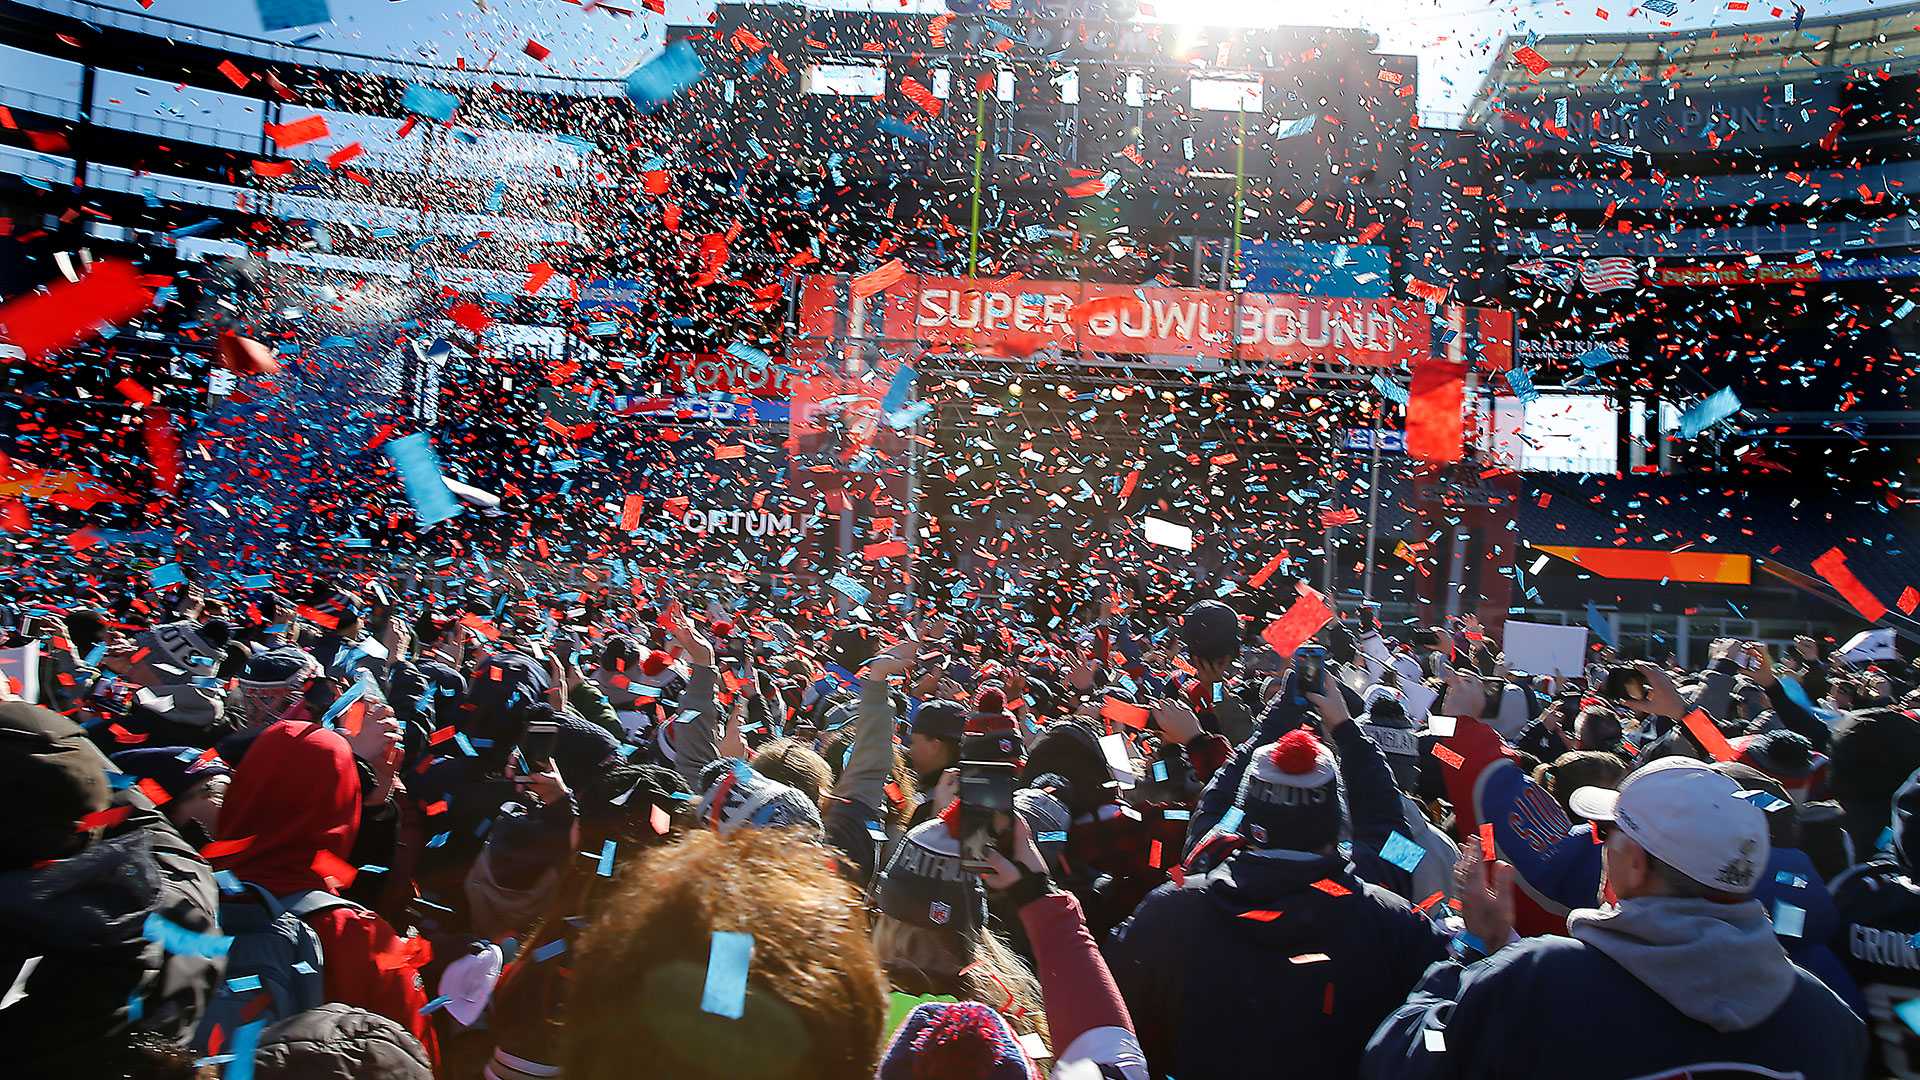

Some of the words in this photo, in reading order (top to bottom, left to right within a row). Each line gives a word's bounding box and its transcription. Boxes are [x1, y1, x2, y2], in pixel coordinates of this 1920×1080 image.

[916, 289, 1076, 336] SUPER
[1240, 304, 1395, 352] BOUND
[673, 359, 796, 389] TOYOT
